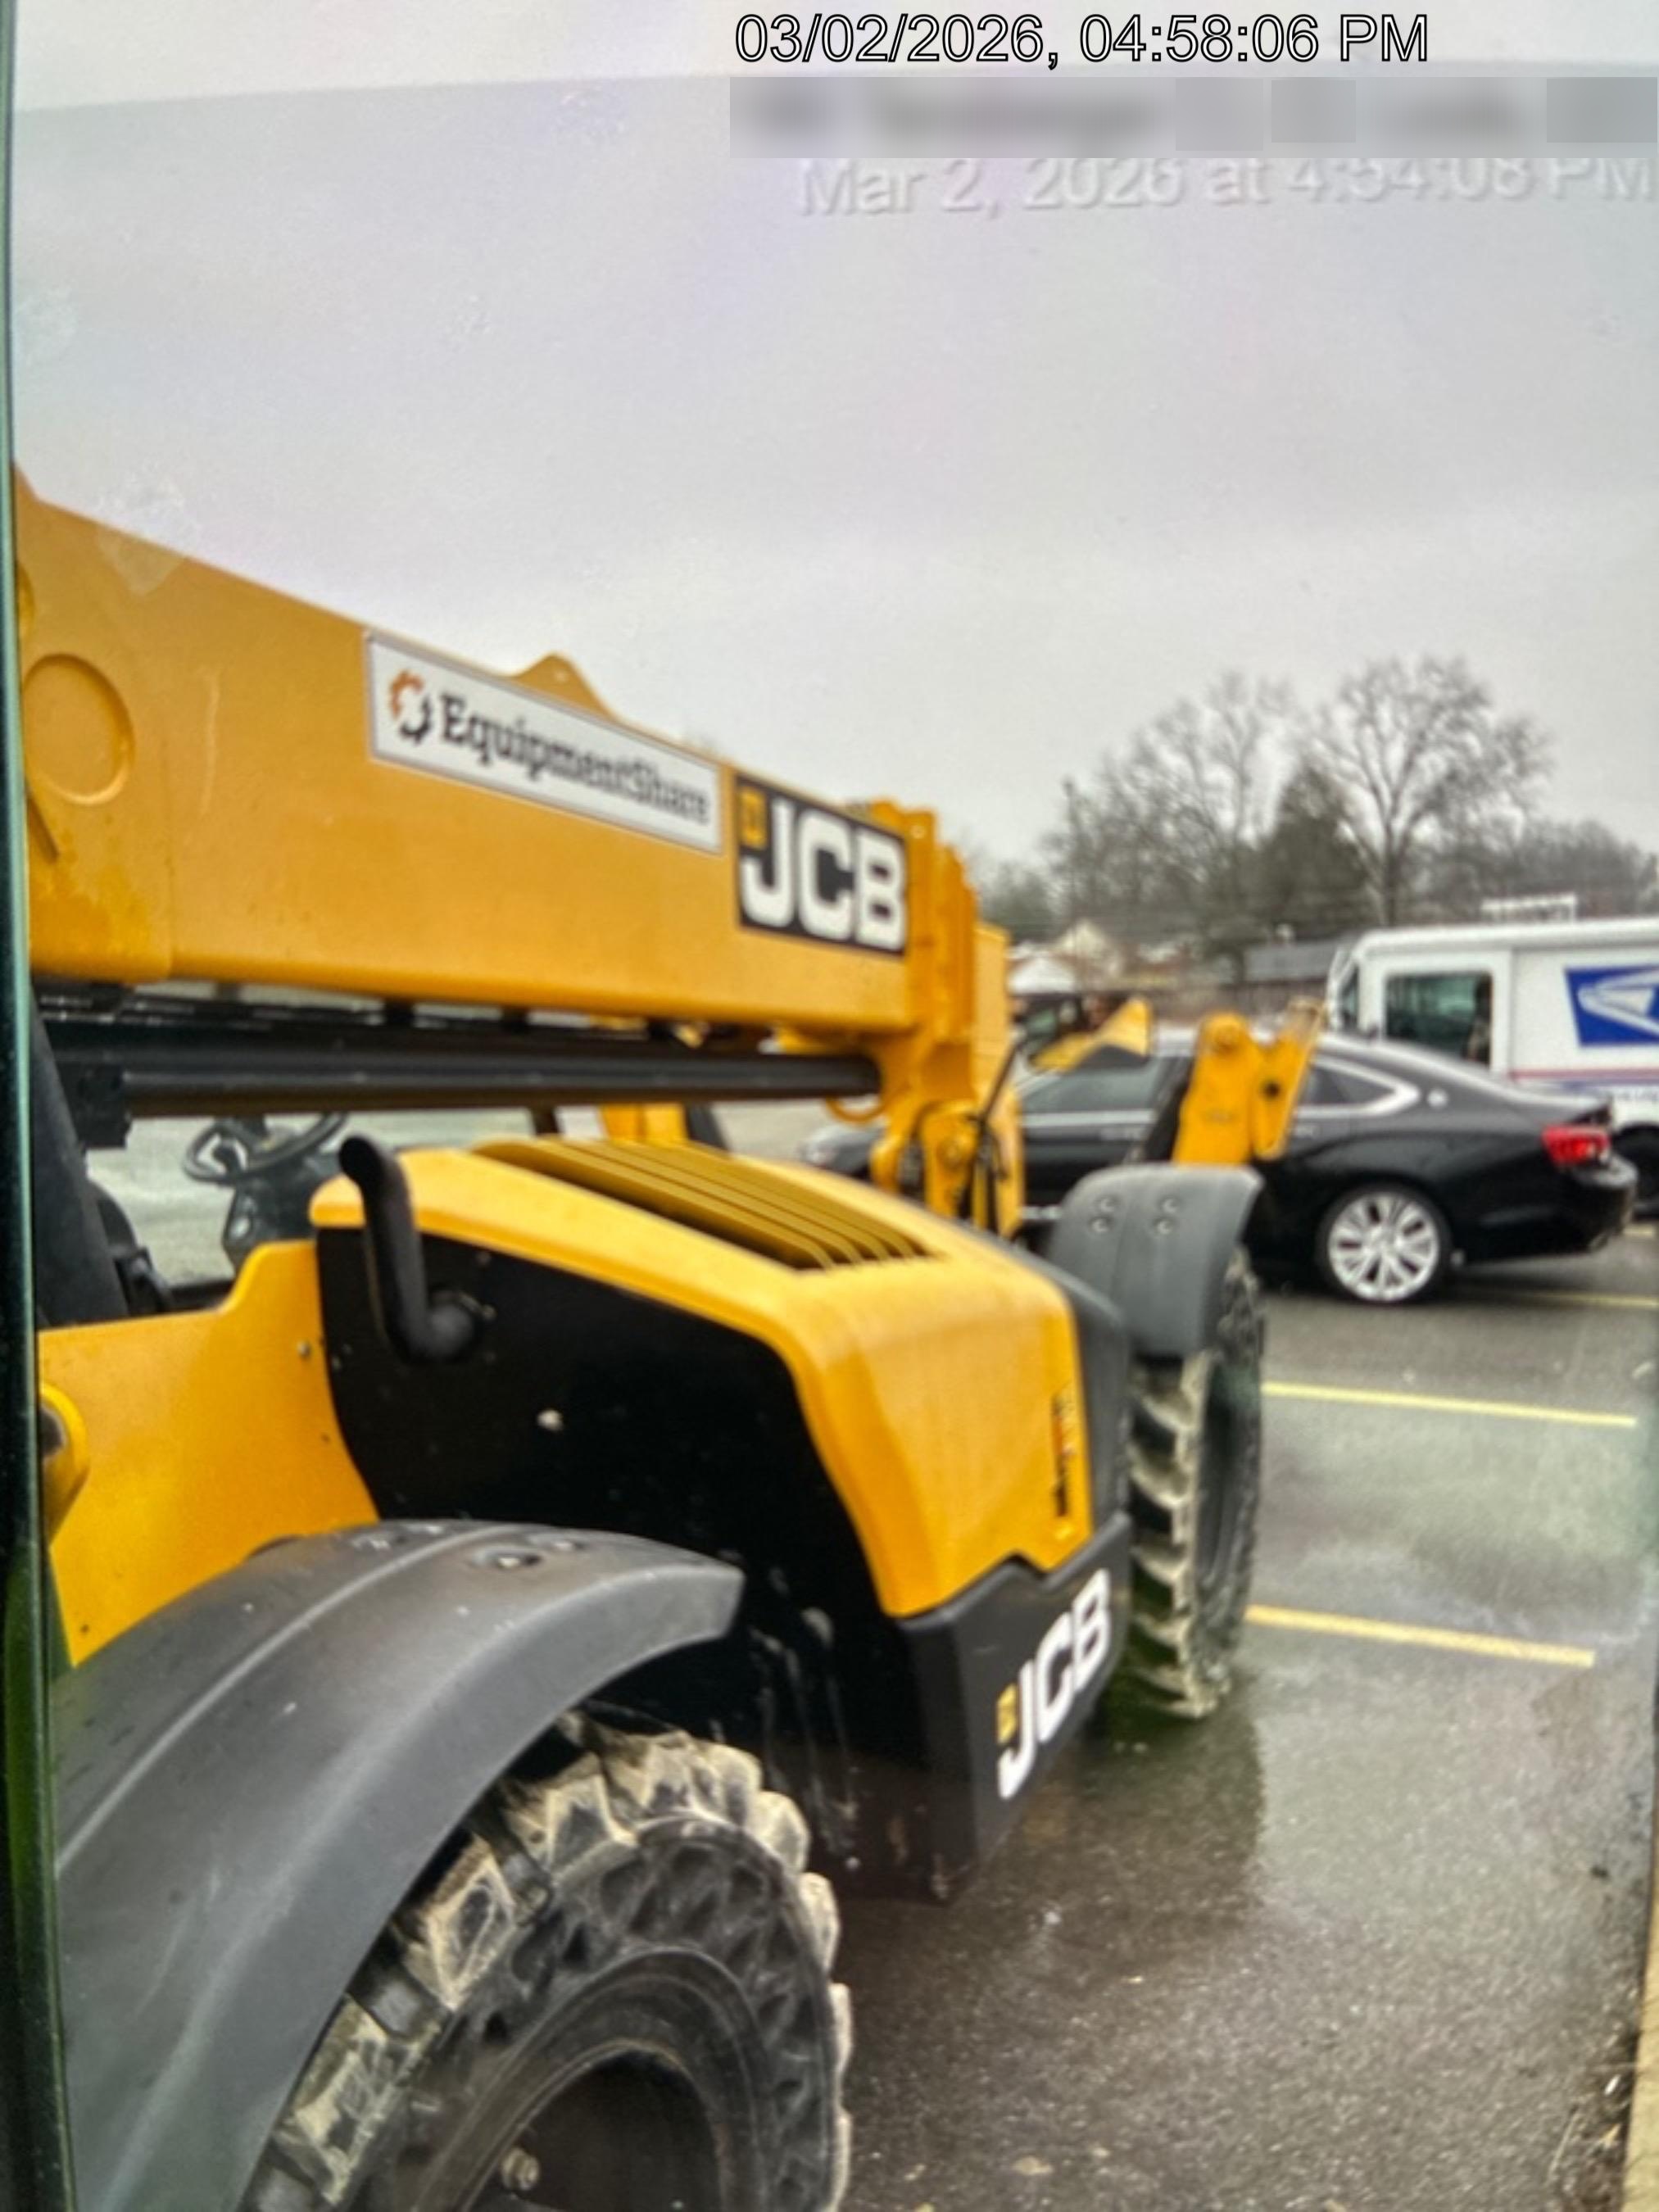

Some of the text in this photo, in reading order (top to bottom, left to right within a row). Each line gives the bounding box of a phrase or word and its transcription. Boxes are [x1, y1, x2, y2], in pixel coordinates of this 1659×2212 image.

[441, 692, 709, 827] EquipmentShare
[739, 798, 905, 952] JCB
[997, 1567, 1110, 1799] JCB
